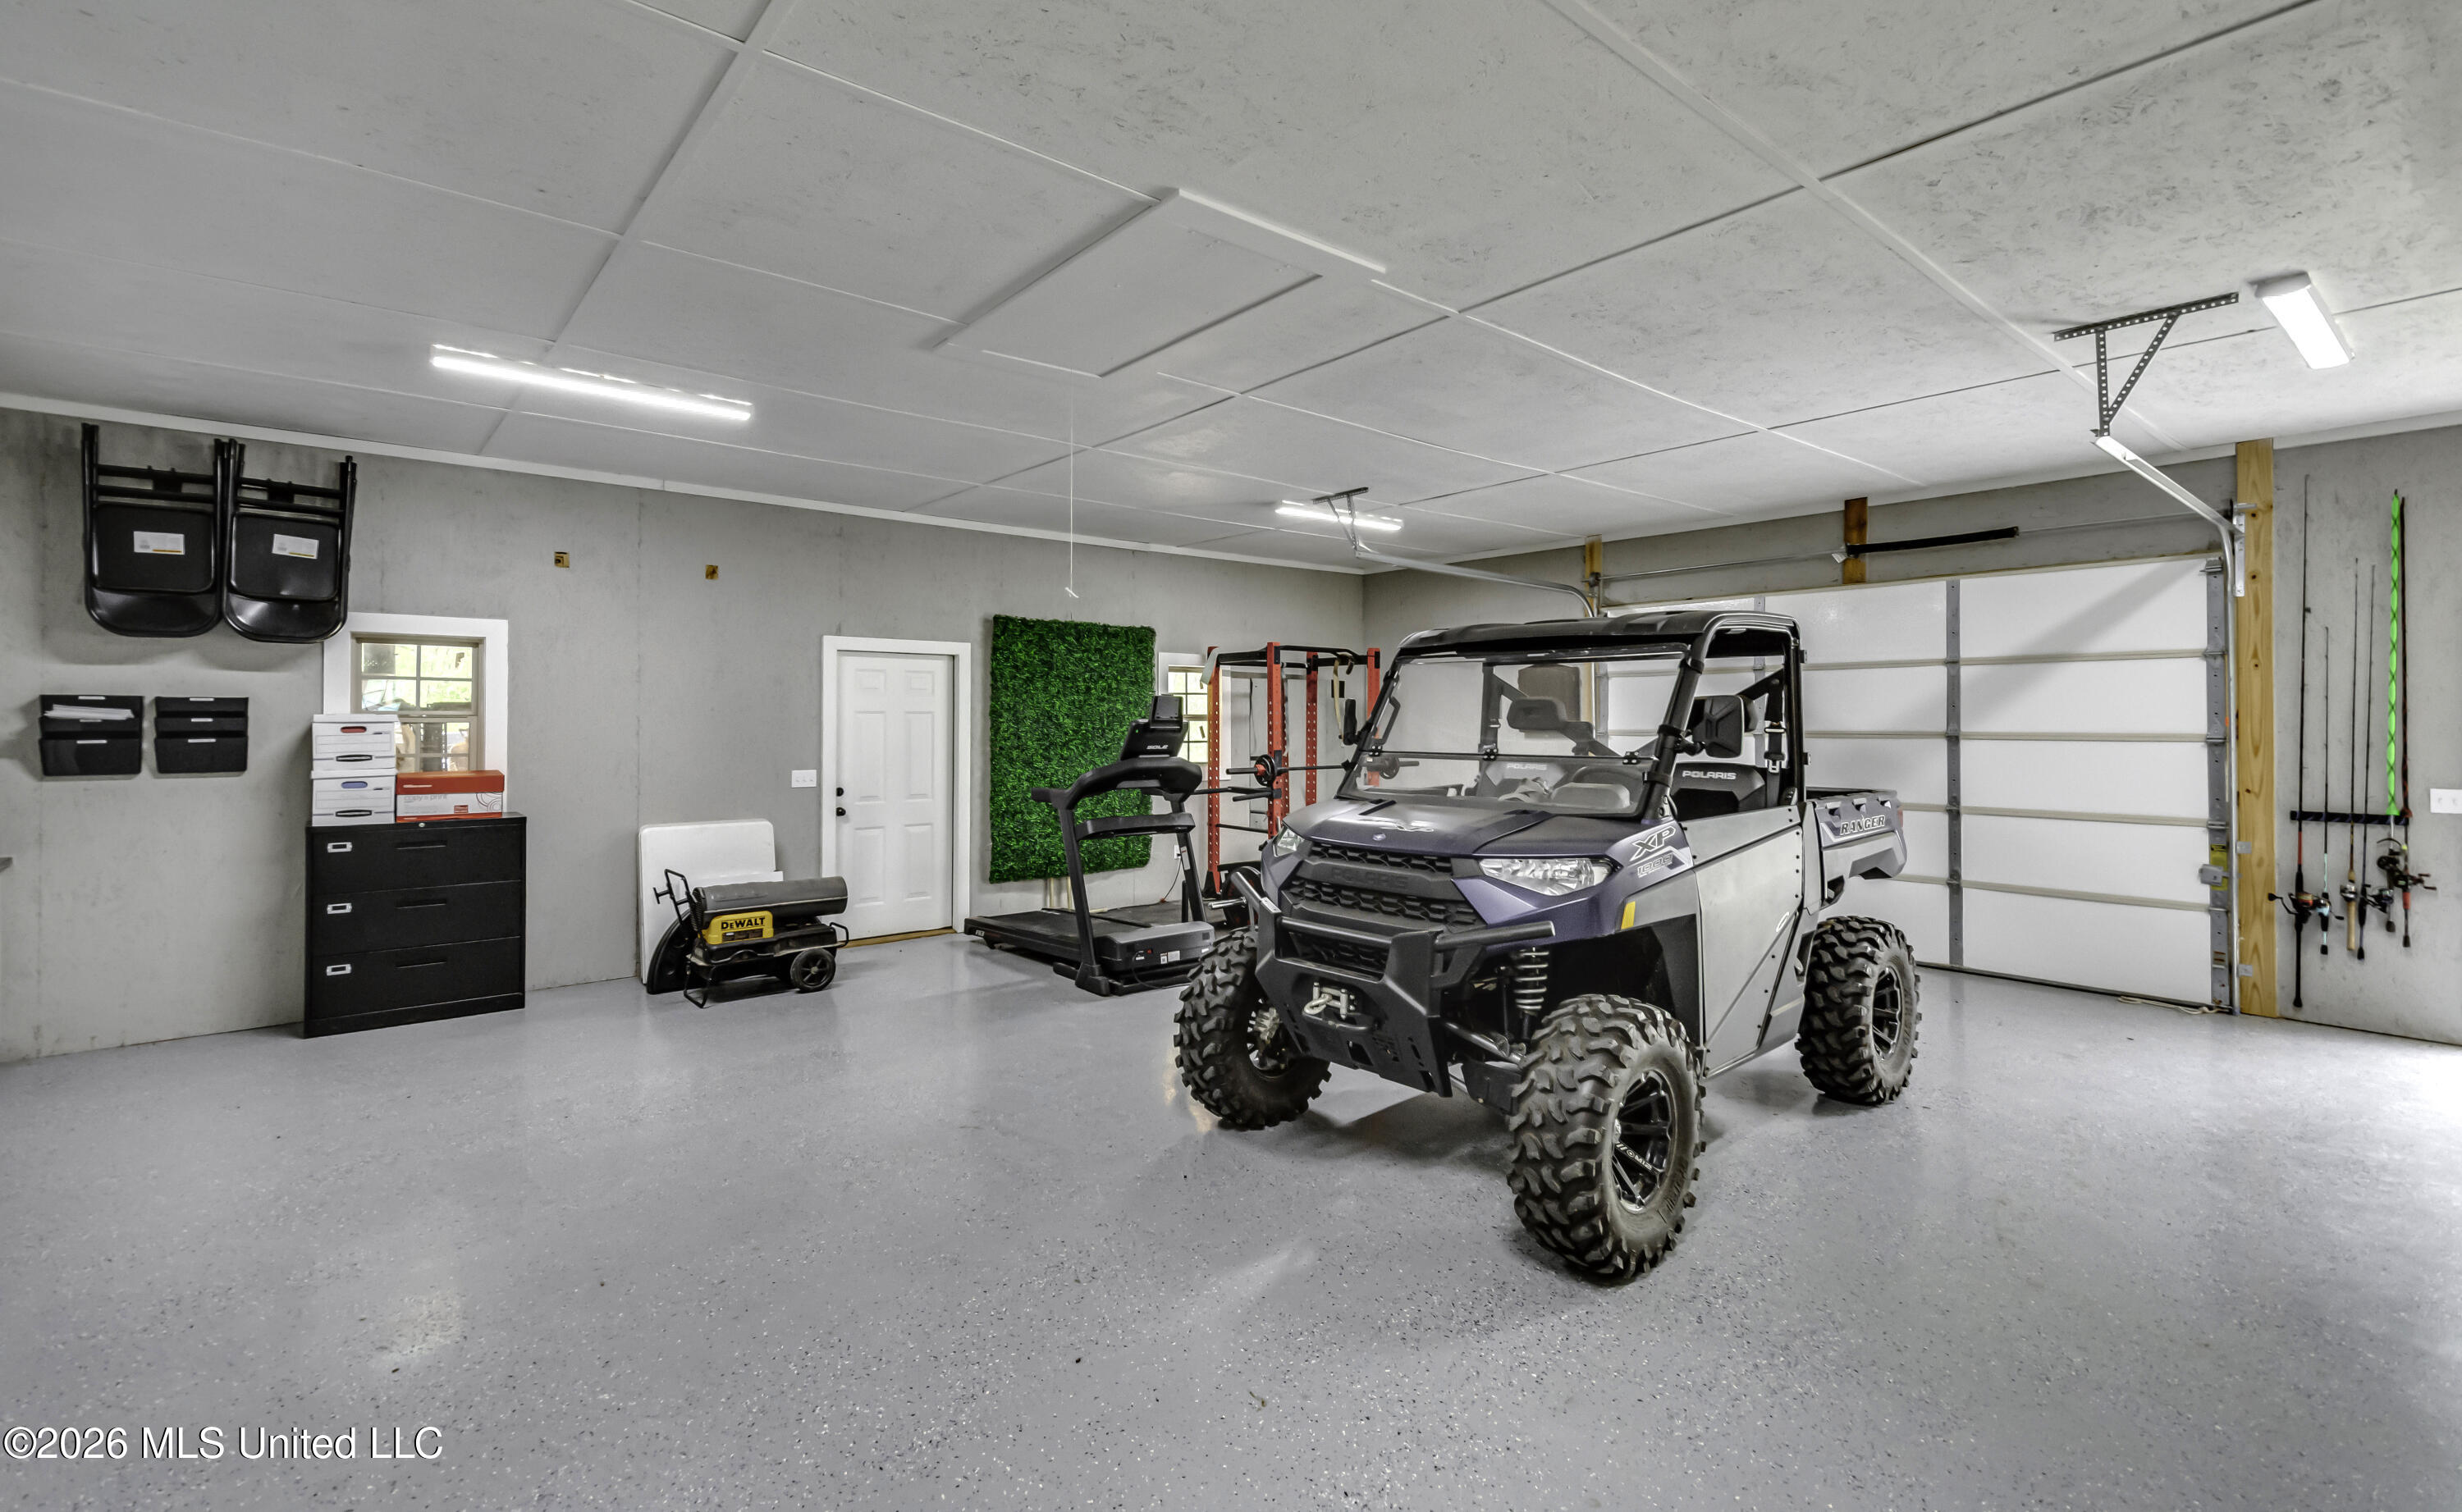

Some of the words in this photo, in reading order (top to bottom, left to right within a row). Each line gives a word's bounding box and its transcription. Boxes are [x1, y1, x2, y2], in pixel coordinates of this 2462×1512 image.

[1682, 770, 1737, 780] POLARIS
[1840, 815, 1886, 836] RANGER
[1628, 825, 1677, 861] XP
